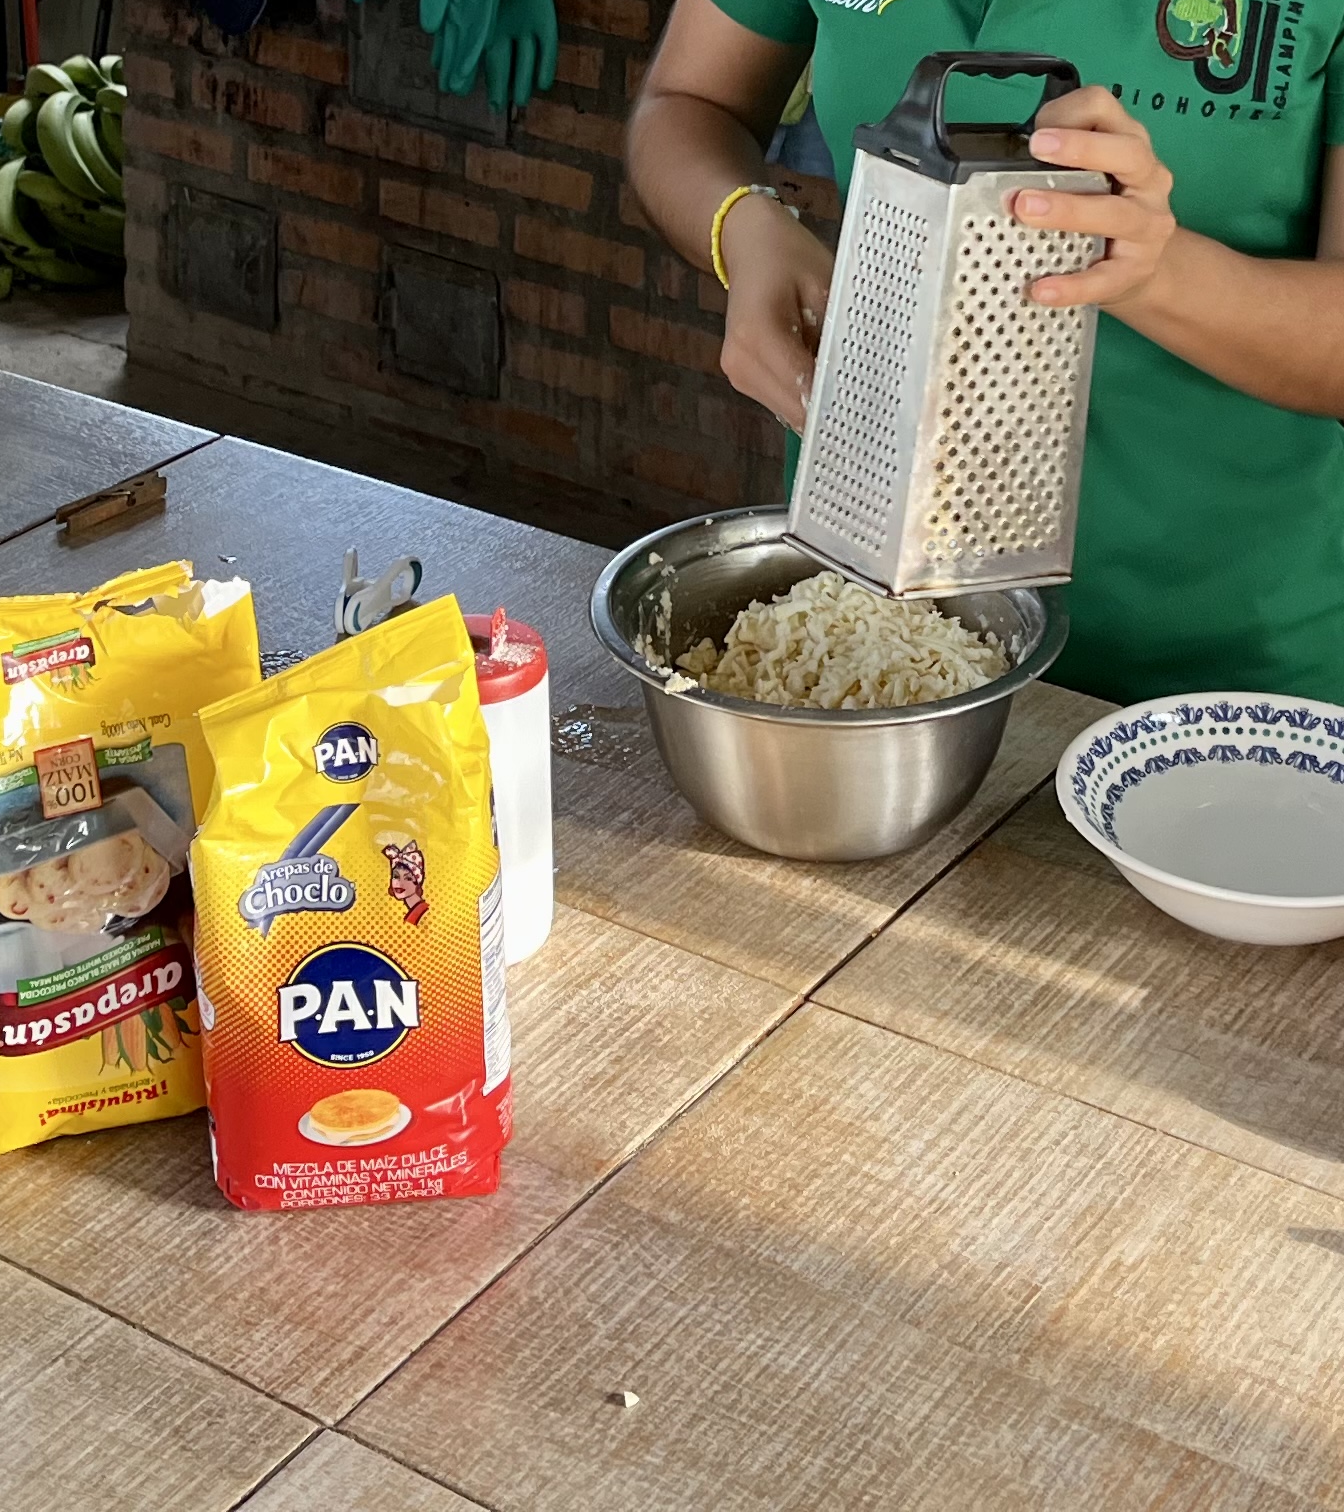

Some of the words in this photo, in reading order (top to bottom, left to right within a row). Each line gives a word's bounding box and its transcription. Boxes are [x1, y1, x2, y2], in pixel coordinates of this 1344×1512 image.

[50, 753, 81, 767] CORN
[260, 862, 310, 884] Arepas
[313, 858, 333, 874] de
[244, 874, 348, 914] Choclo
[102, 934, 151, 960] PRE-COOKED
[131, 938, 161, 957] HARINA
[76, 957, 102, 974] WHITE
[120, 951, 132, 963] DE
[29, 976, 52, 988] MEAL
[52, 968, 75, 982] CORN
[66, 966, 100, 987] BLANCO
[19, 980, 67, 1000] PRECOCIDA
[2, 960, 183, 1047] arepasán
[255, 1174, 286, 1189] CON
[289, 1172, 371, 1188] VITAMINAS
[373, 1170, 385, 1182] Y
[387, 1150, 468, 1181] MINERALES
[273, 1162, 333, 1176] MEZCLA
[337, 1159, 357, 1173] DE
[360, 1154, 398, 1170] MAÍZ
[401, 1144, 449, 1167] DULCE
[283, 1184, 369, 1201] CONTENIDO
[370, 1192, 392, 1202] 33
